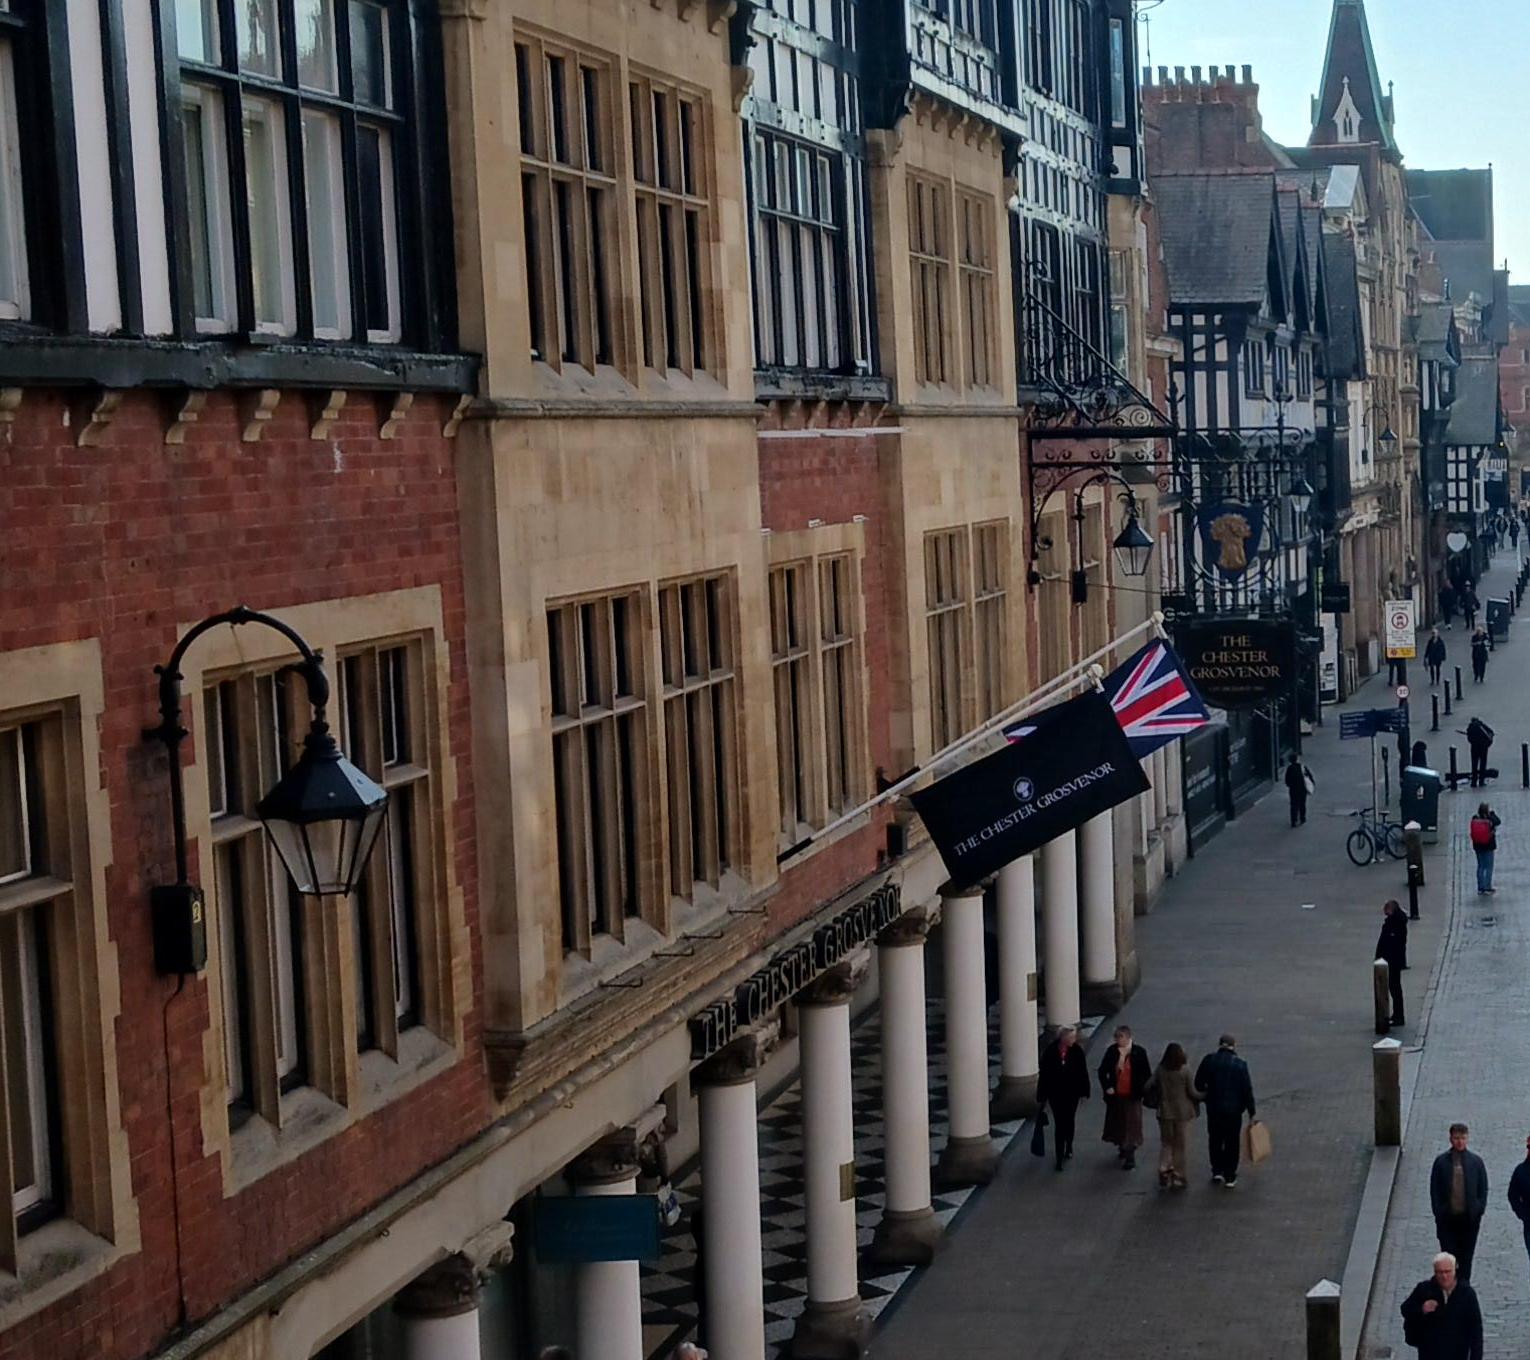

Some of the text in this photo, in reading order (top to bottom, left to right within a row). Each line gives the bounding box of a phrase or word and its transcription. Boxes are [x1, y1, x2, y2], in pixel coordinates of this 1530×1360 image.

[1222, 635, 1251, 647] THE
[1202, 650, 1268, 663] CHESTER
[1190, 665, 1281, 679] GROSVENOR
[953, 761, 1115, 856] THE CHESTER GROSVENOR
[699, 1000, 738, 1058] THE
[746, 940, 817, 1025] CHESTER
